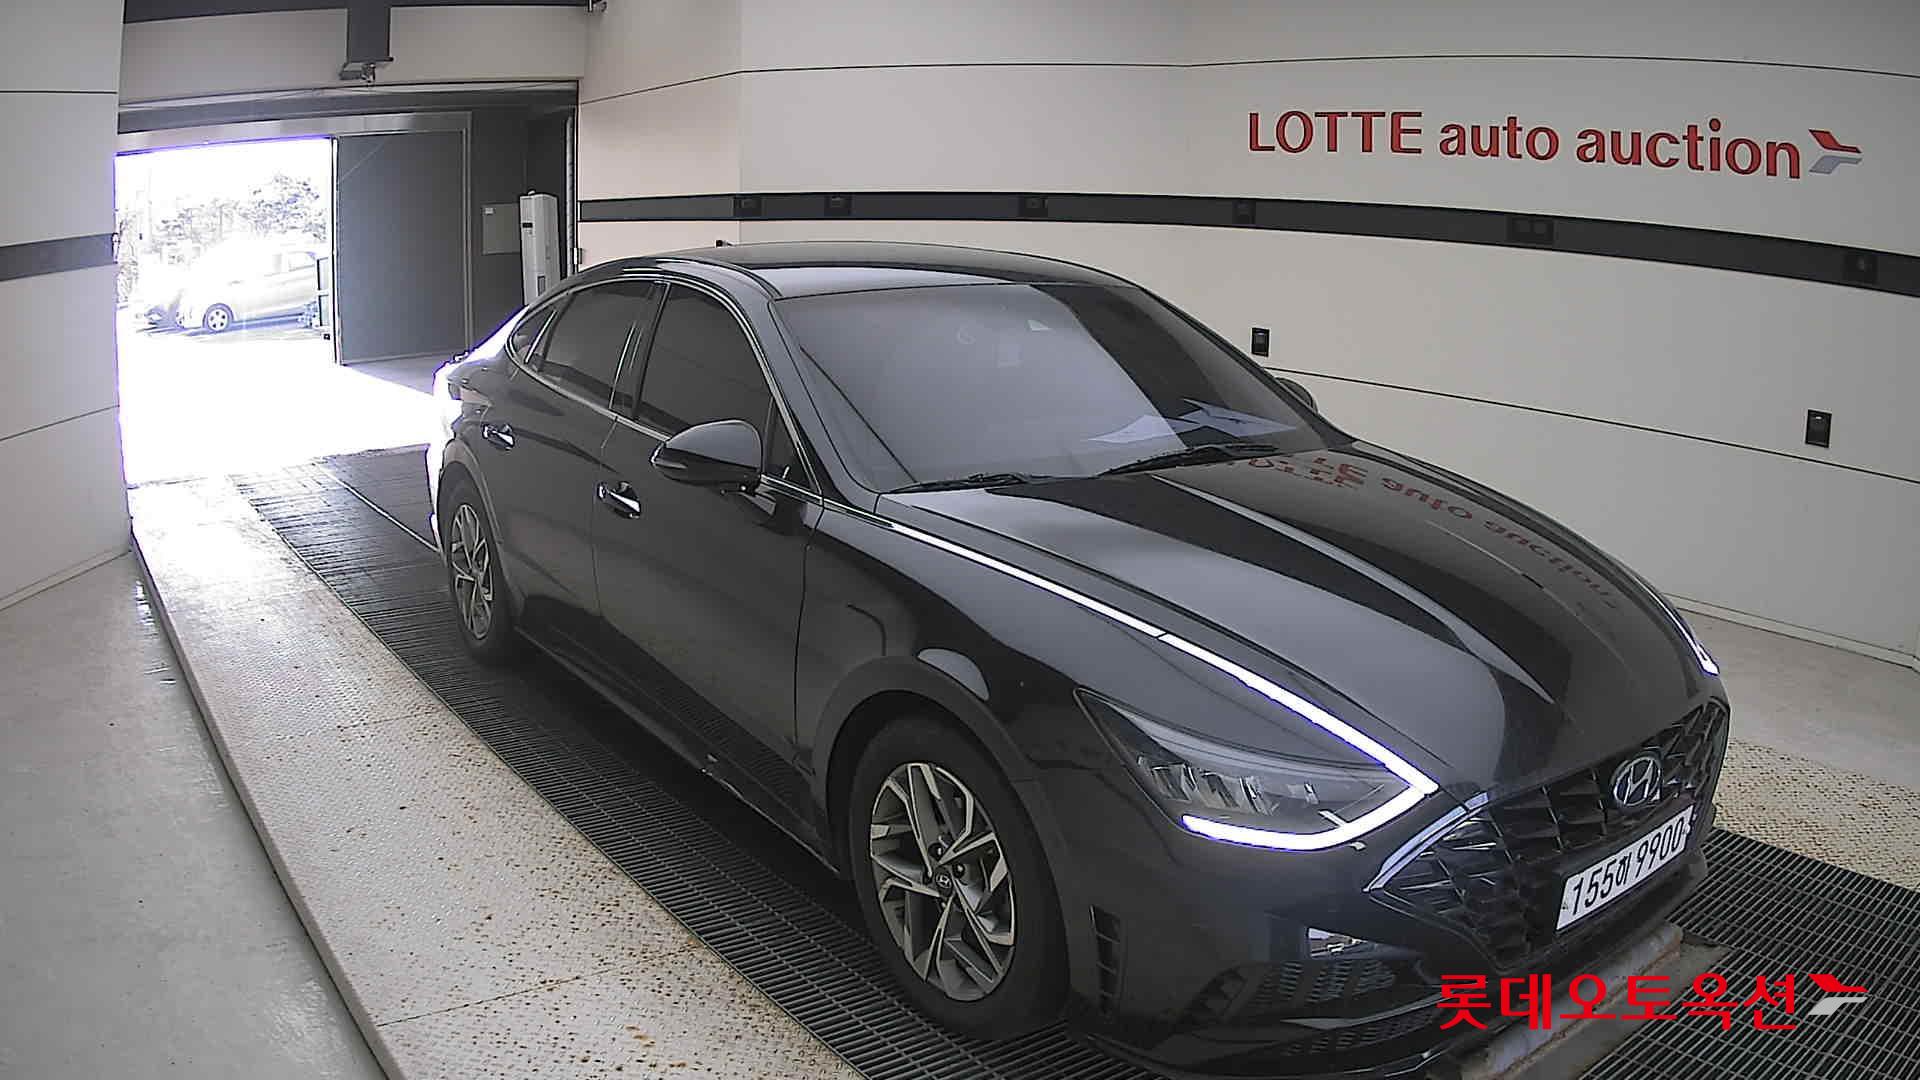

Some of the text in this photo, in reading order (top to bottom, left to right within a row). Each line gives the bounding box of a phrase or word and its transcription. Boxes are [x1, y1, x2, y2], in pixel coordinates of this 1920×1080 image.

[1248, 110, 1801, 179] LOTTE auto auction
